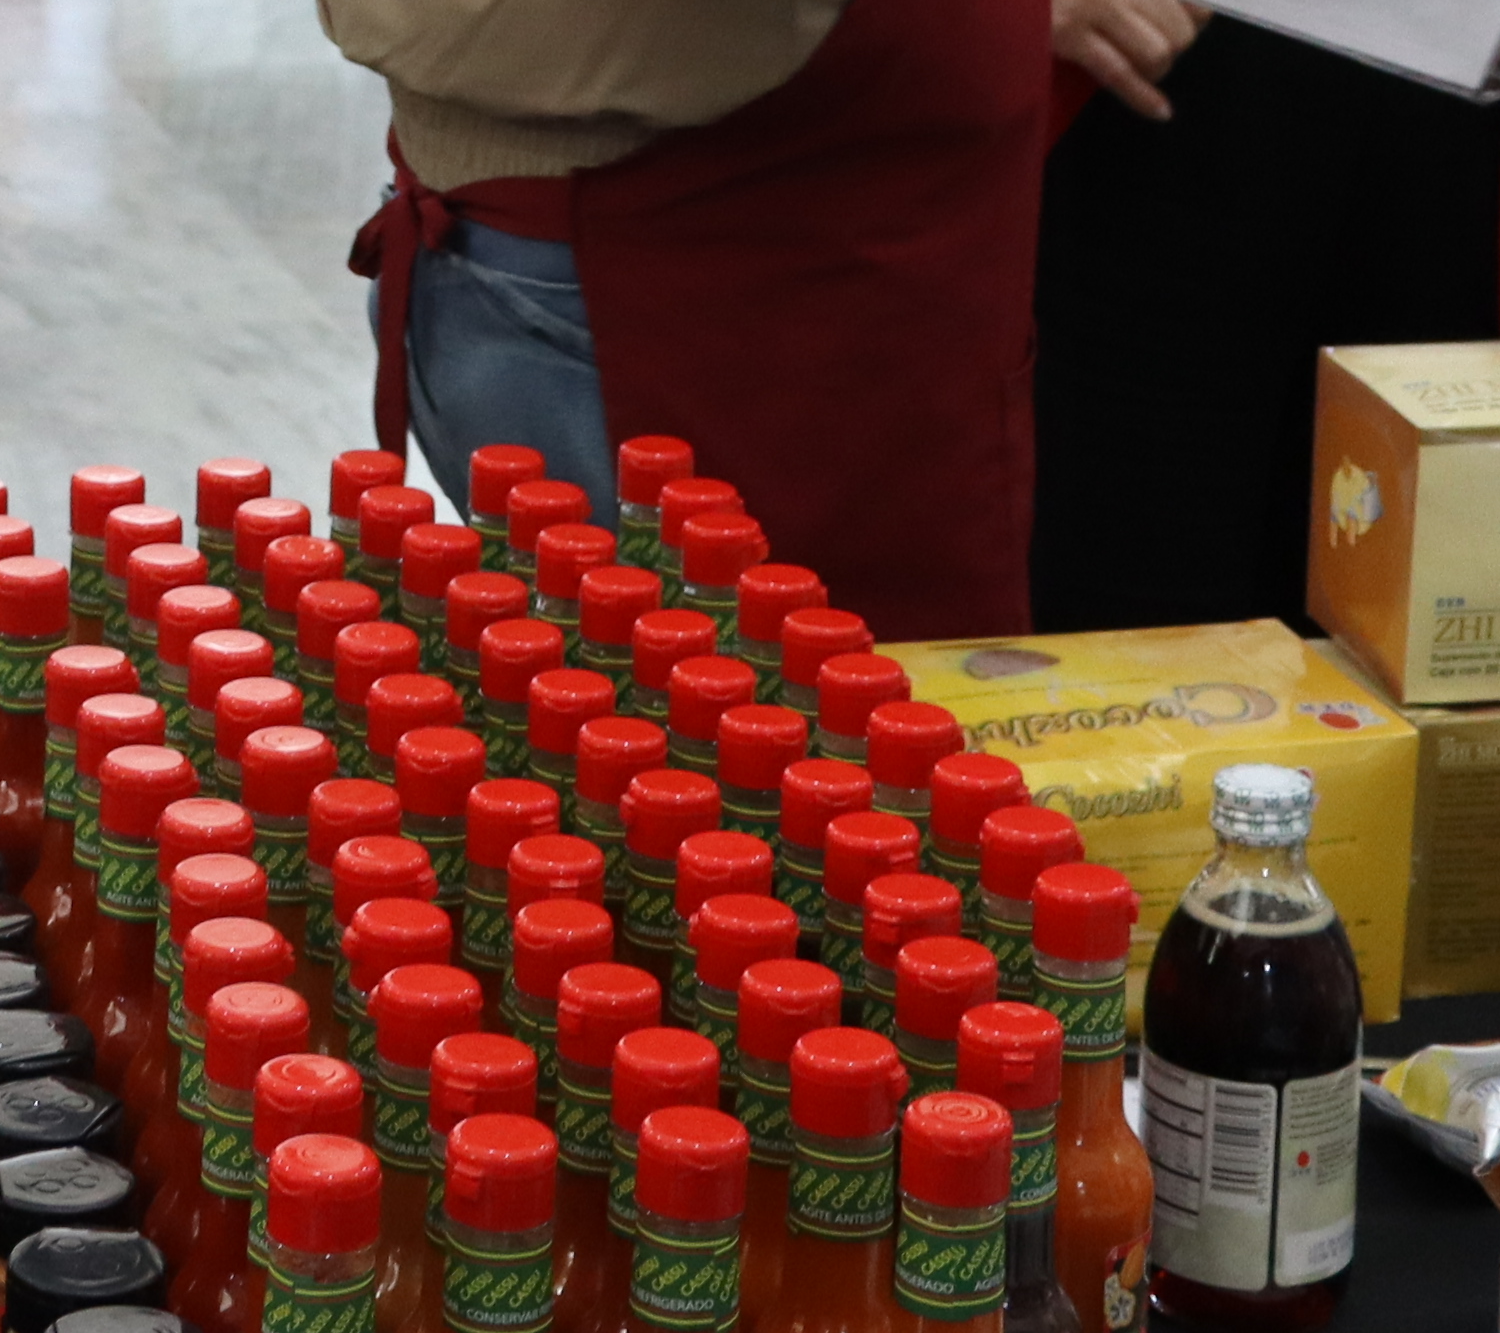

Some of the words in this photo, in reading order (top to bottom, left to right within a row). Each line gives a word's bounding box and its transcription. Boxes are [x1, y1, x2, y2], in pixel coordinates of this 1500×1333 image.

[1434, 616, 1496, 643] ZHI
[1084, 998, 1113, 1032] CASSU
[1064, 1034, 1099, 1046] ANTES
[210, 1133, 237, 1161] CASSU
[808, 1174, 840, 1205] CASSU
[831, 1175, 865, 1210] CASSU
[858, 1171, 885, 1210] CASSU
[800, 1203, 832, 1222] AGITE
[834, 1211, 872, 1225] ANTES
[921, 1245, 966, 1276] CASSU
[960, 1239, 990, 1280] CASSU
[482, 1272, 519, 1307] CASSU
[509, 1269, 540, 1308] CASSU
[652, 1261, 687, 1292] CASSU
[466, 1309, 539, 1325] CONSERVAR
